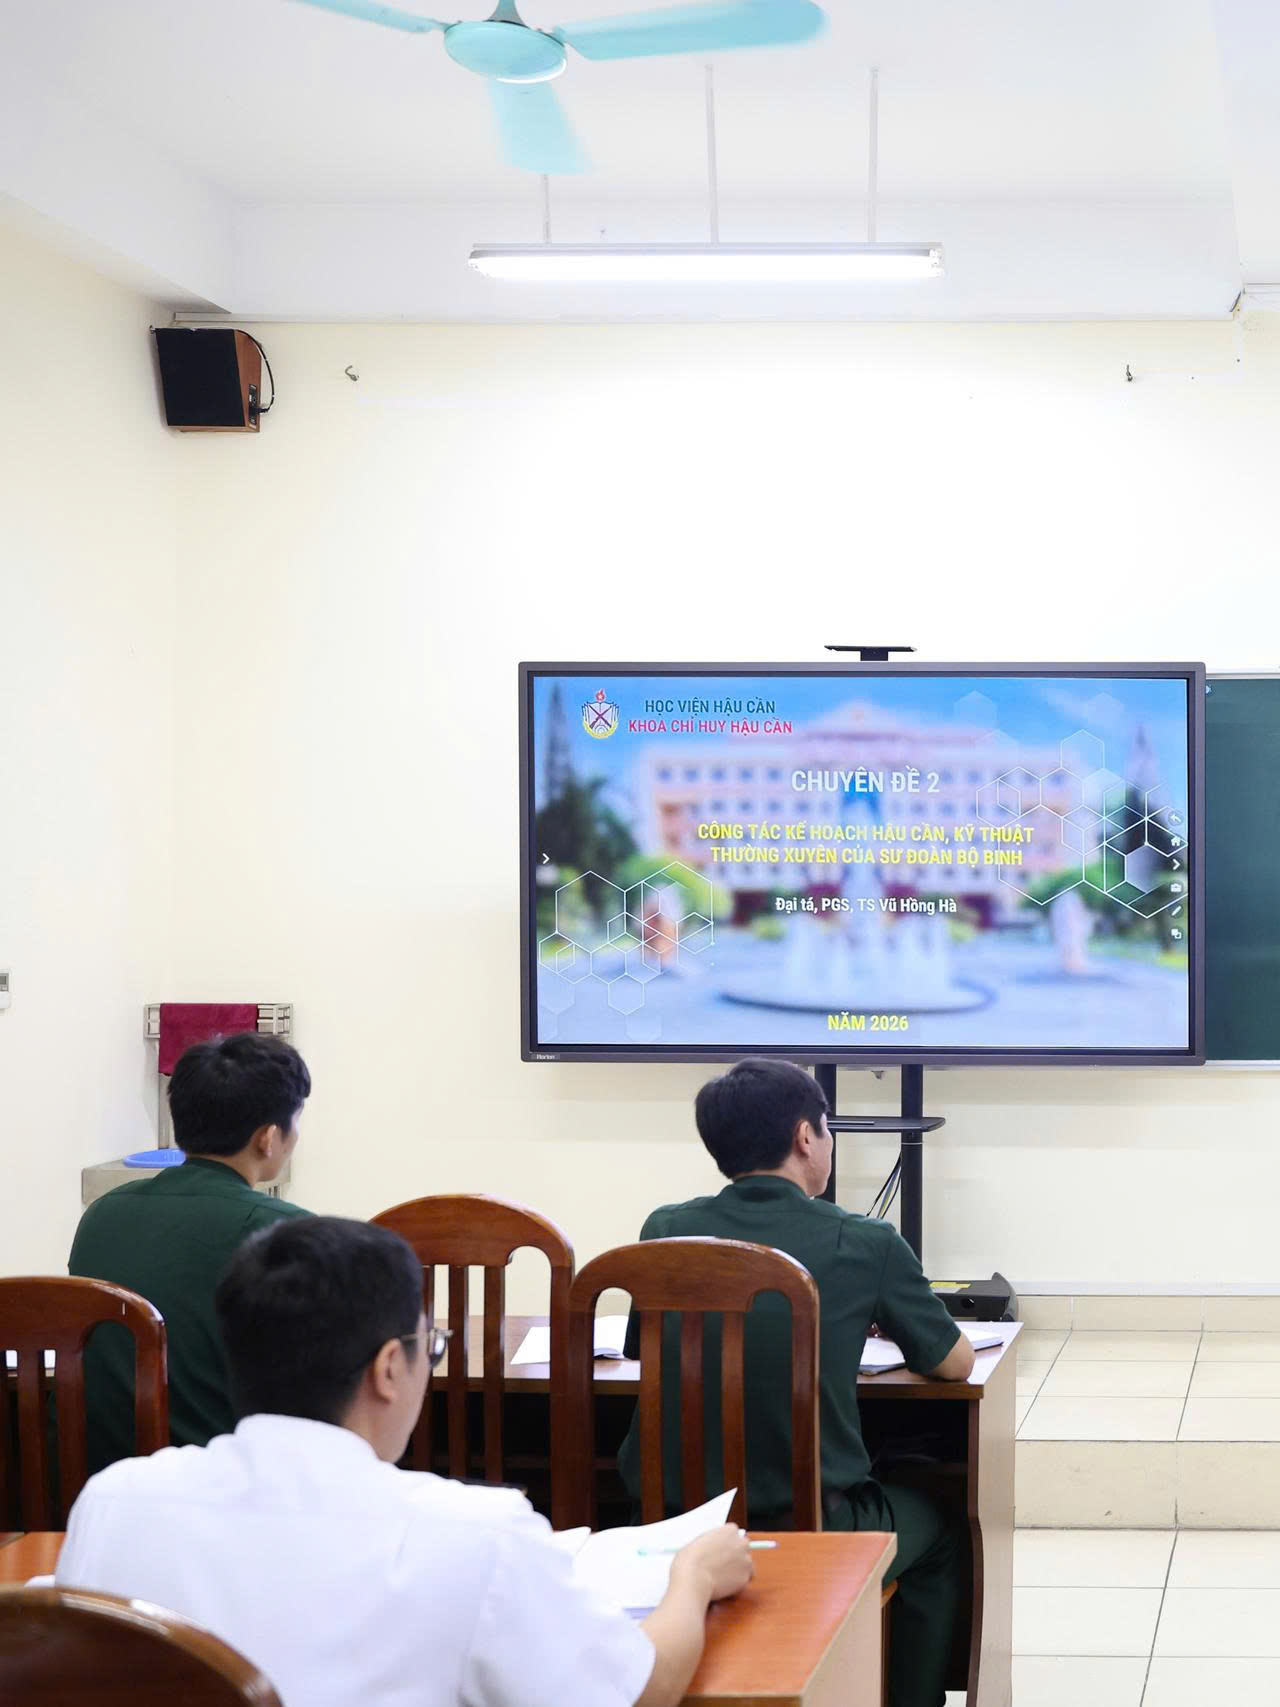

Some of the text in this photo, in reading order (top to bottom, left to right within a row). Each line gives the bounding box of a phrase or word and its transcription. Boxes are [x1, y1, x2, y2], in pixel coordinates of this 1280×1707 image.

[645, 696, 776, 717] HỌC VIỆN HẬU CẦN
[628, 719, 667, 733] KHOA
[698, 719, 726, 733] HUY
[731, 718, 759, 736] HẬU
[763, 717, 792, 734] CẦN
[791, 765, 940, 793] CHUYÊN ĐỀ 2
[698, 820, 1034, 846] CÔNG TÁC KẾ HOẠCH HẬU CẦN, KỸ THUẬT
[710, 843, 1023, 868] THƯỜNG XUYÊN CỦA SƯ ĐOÀN BỘ BINH
[775, 897, 957, 916] Đại tá, PGS, TS Vũ Hồng Hà
[827, 1011, 909, 1031] NĂM 2026
